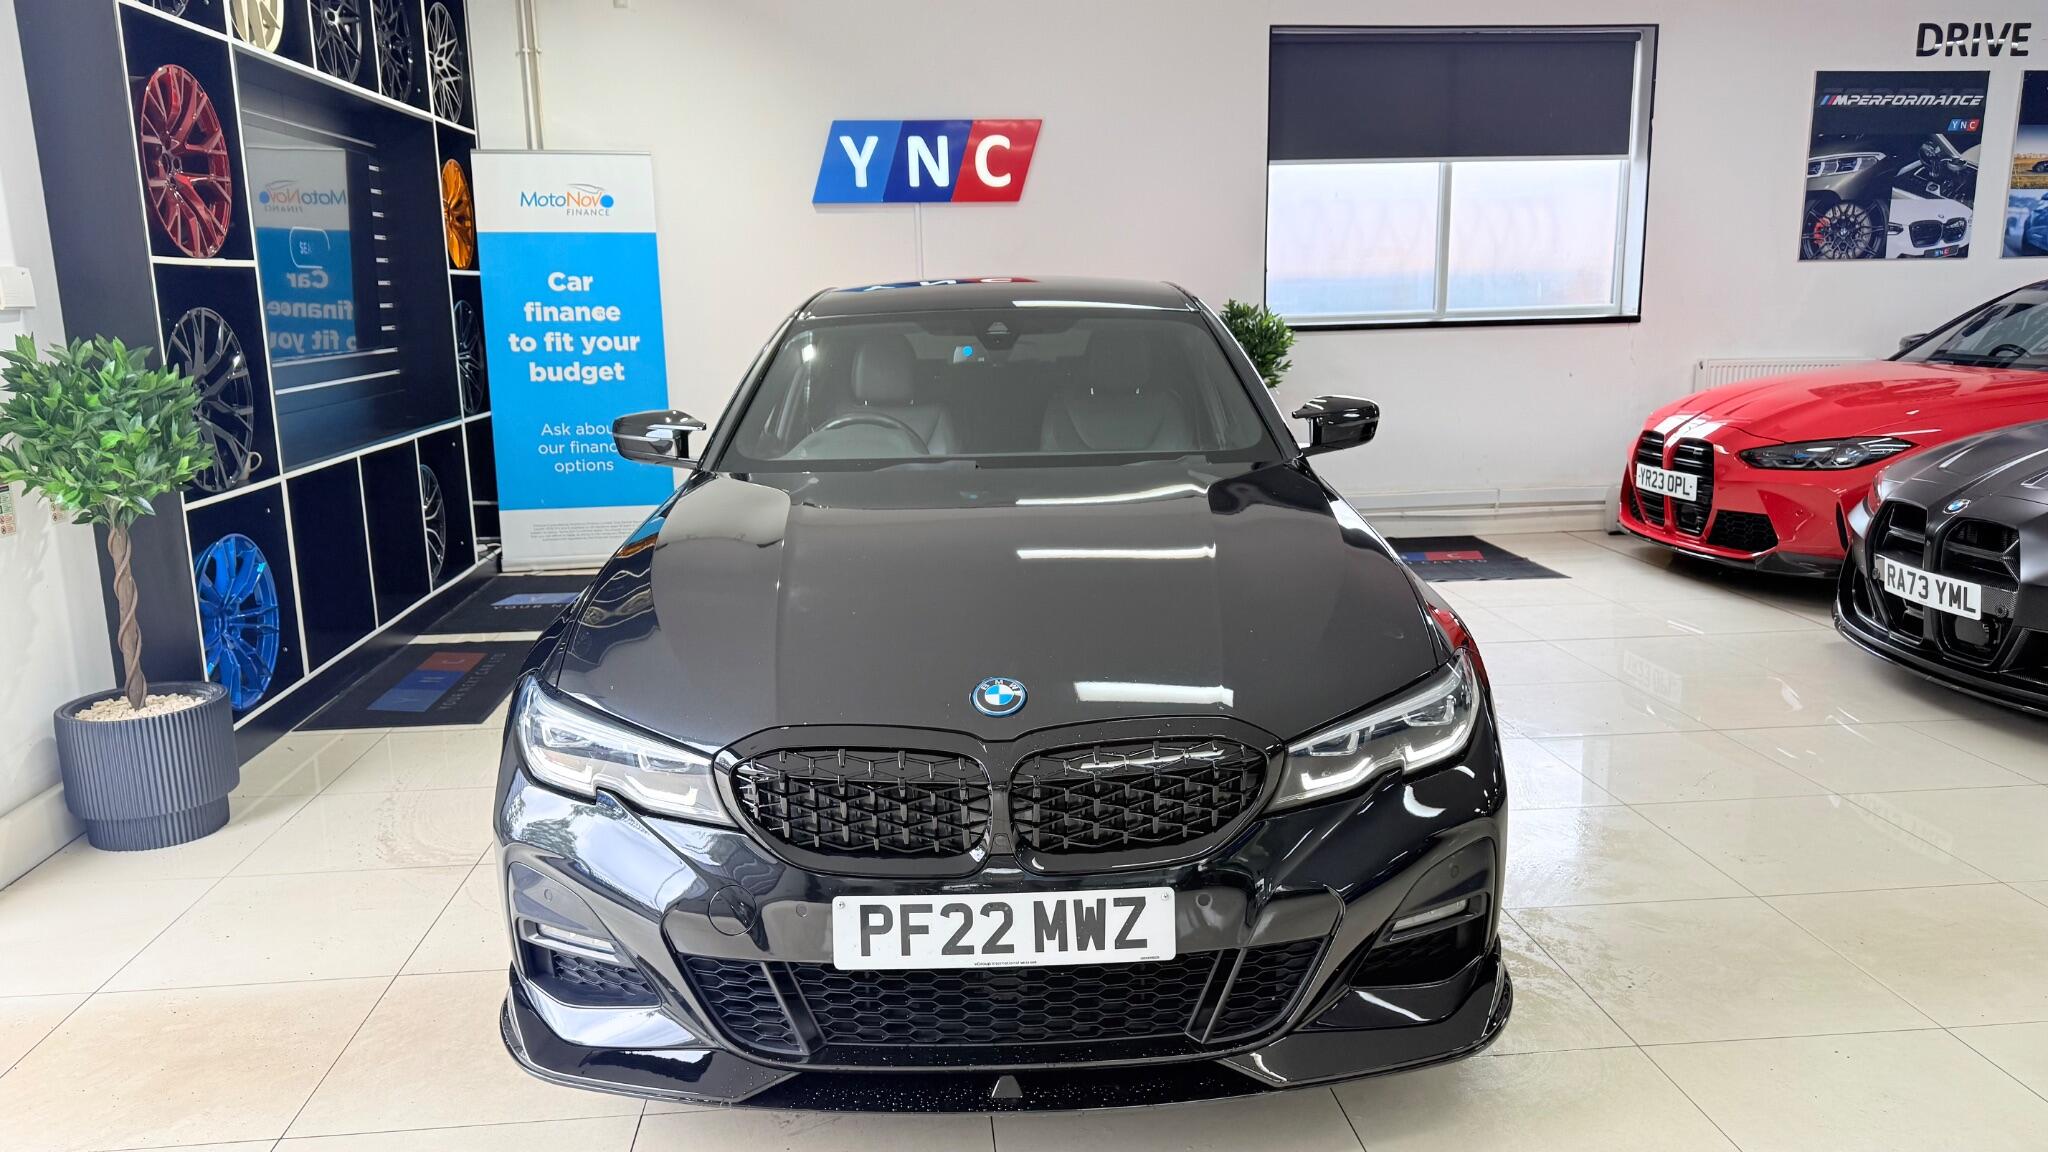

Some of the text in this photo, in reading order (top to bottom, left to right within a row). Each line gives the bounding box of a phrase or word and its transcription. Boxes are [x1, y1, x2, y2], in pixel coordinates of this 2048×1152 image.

[1915, 22, 2032, 57] DRIVE
[1951, 120, 1977, 130] YNC
[839, 134, 1012, 188] YNC
[566, 208, 610, 217] FINANCE
[548, 271, 593, 292] Car
[524, 301, 621, 322] finance
[508, 331, 640, 355] to fit your
[529, 361, 625, 385] budget
[541, 422, 613, 436] Ask abou
[538, 441, 618, 455] our financ
[554, 459, 614, 474] options
[1640, 466, 1690, 496] YR23 OPL
[1887, 563, 1976, 613] RA73 YML
[859, 896, 1148, 957] PF22 MWZ
